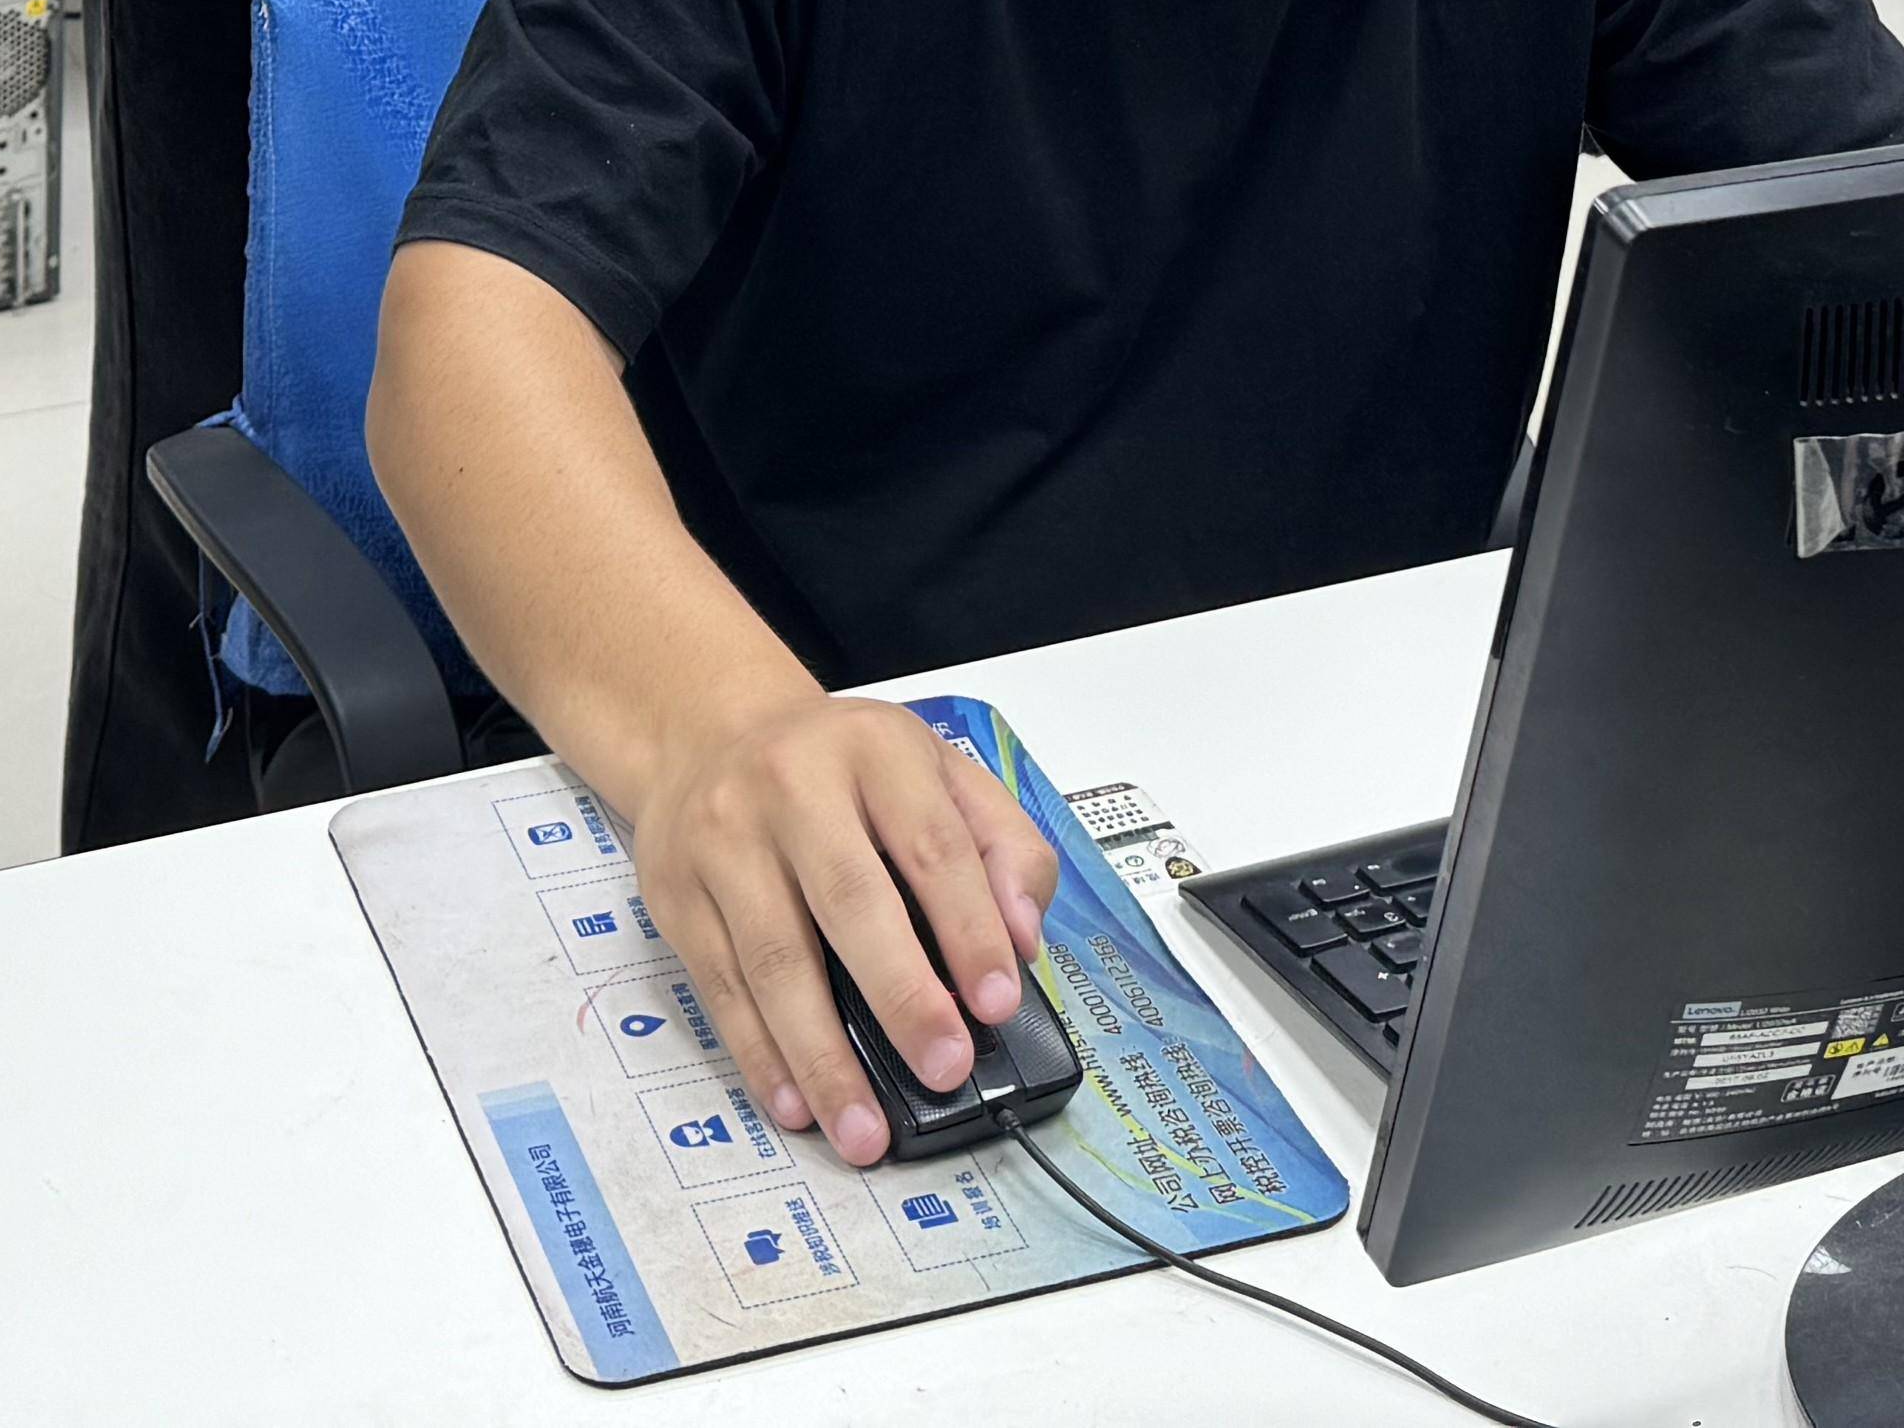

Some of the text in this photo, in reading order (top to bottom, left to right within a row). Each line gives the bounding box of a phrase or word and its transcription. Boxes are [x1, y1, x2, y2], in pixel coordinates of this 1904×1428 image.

[1047, 943, 1123, 1036] 4000110088
[1086, 934, 1165, 1029] 4006112366
[528, 1142, 637, 1340] 河南航天金穗电子有限公司
[783, 1196, 844, 1278] 涉税知识推送
[955, 1170, 1002, 1231] 培训报名
